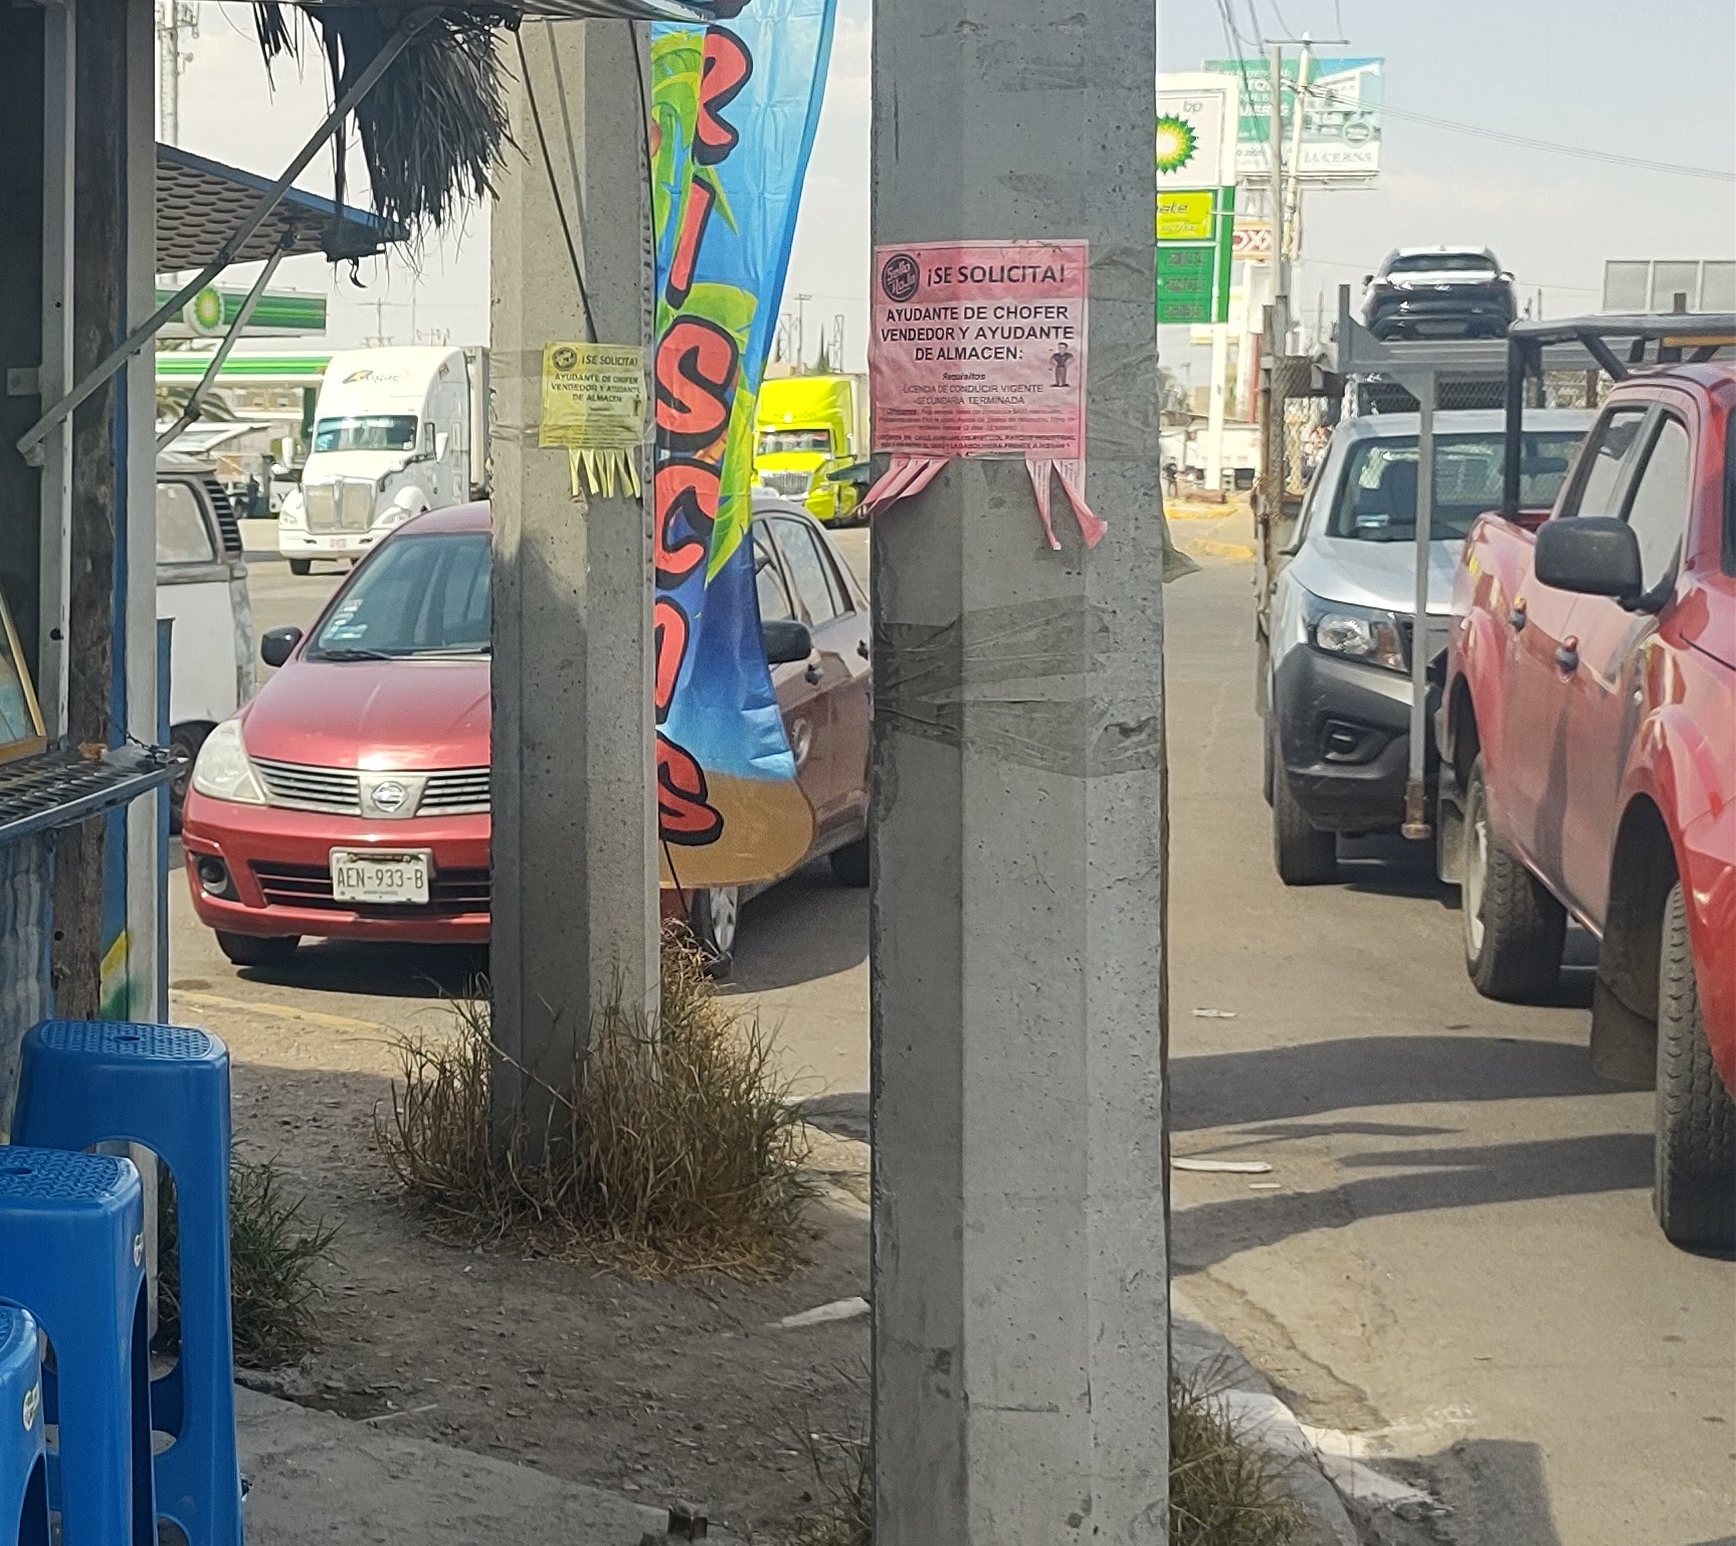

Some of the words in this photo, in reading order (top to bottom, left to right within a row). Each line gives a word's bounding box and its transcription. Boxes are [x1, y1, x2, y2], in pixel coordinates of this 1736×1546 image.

[927, 267, 953, 287] ¡SE
[957, 265, 1065, 284] SOLICITA!
[886, 307, 959, 322] AYUDANTE
[964, 306, 988, 320] DE
[993, 306, 1068, 320] CHOFER
[881, 327, 955, 342] VENDEDOR
[959, 326, 970, 340] Y
[974, 326, 1075, 340] AYUDANTE
[915, 347, 933, 361] DE
[936, 346, 1024, 361] ALMACEN:
[555, 373, 600, 383] AYUDANTE
[551, 383, 598, 392] VENDEDOR
[950, 384, 999, 394] CONDUCIR
[1001, 384, 1044, 393] VIGENTE
[572, 393, 584, 401] DE
[968, 395, 1025, 405] TERMINADA
[337, 867, 424, 889] AEN-933-B
